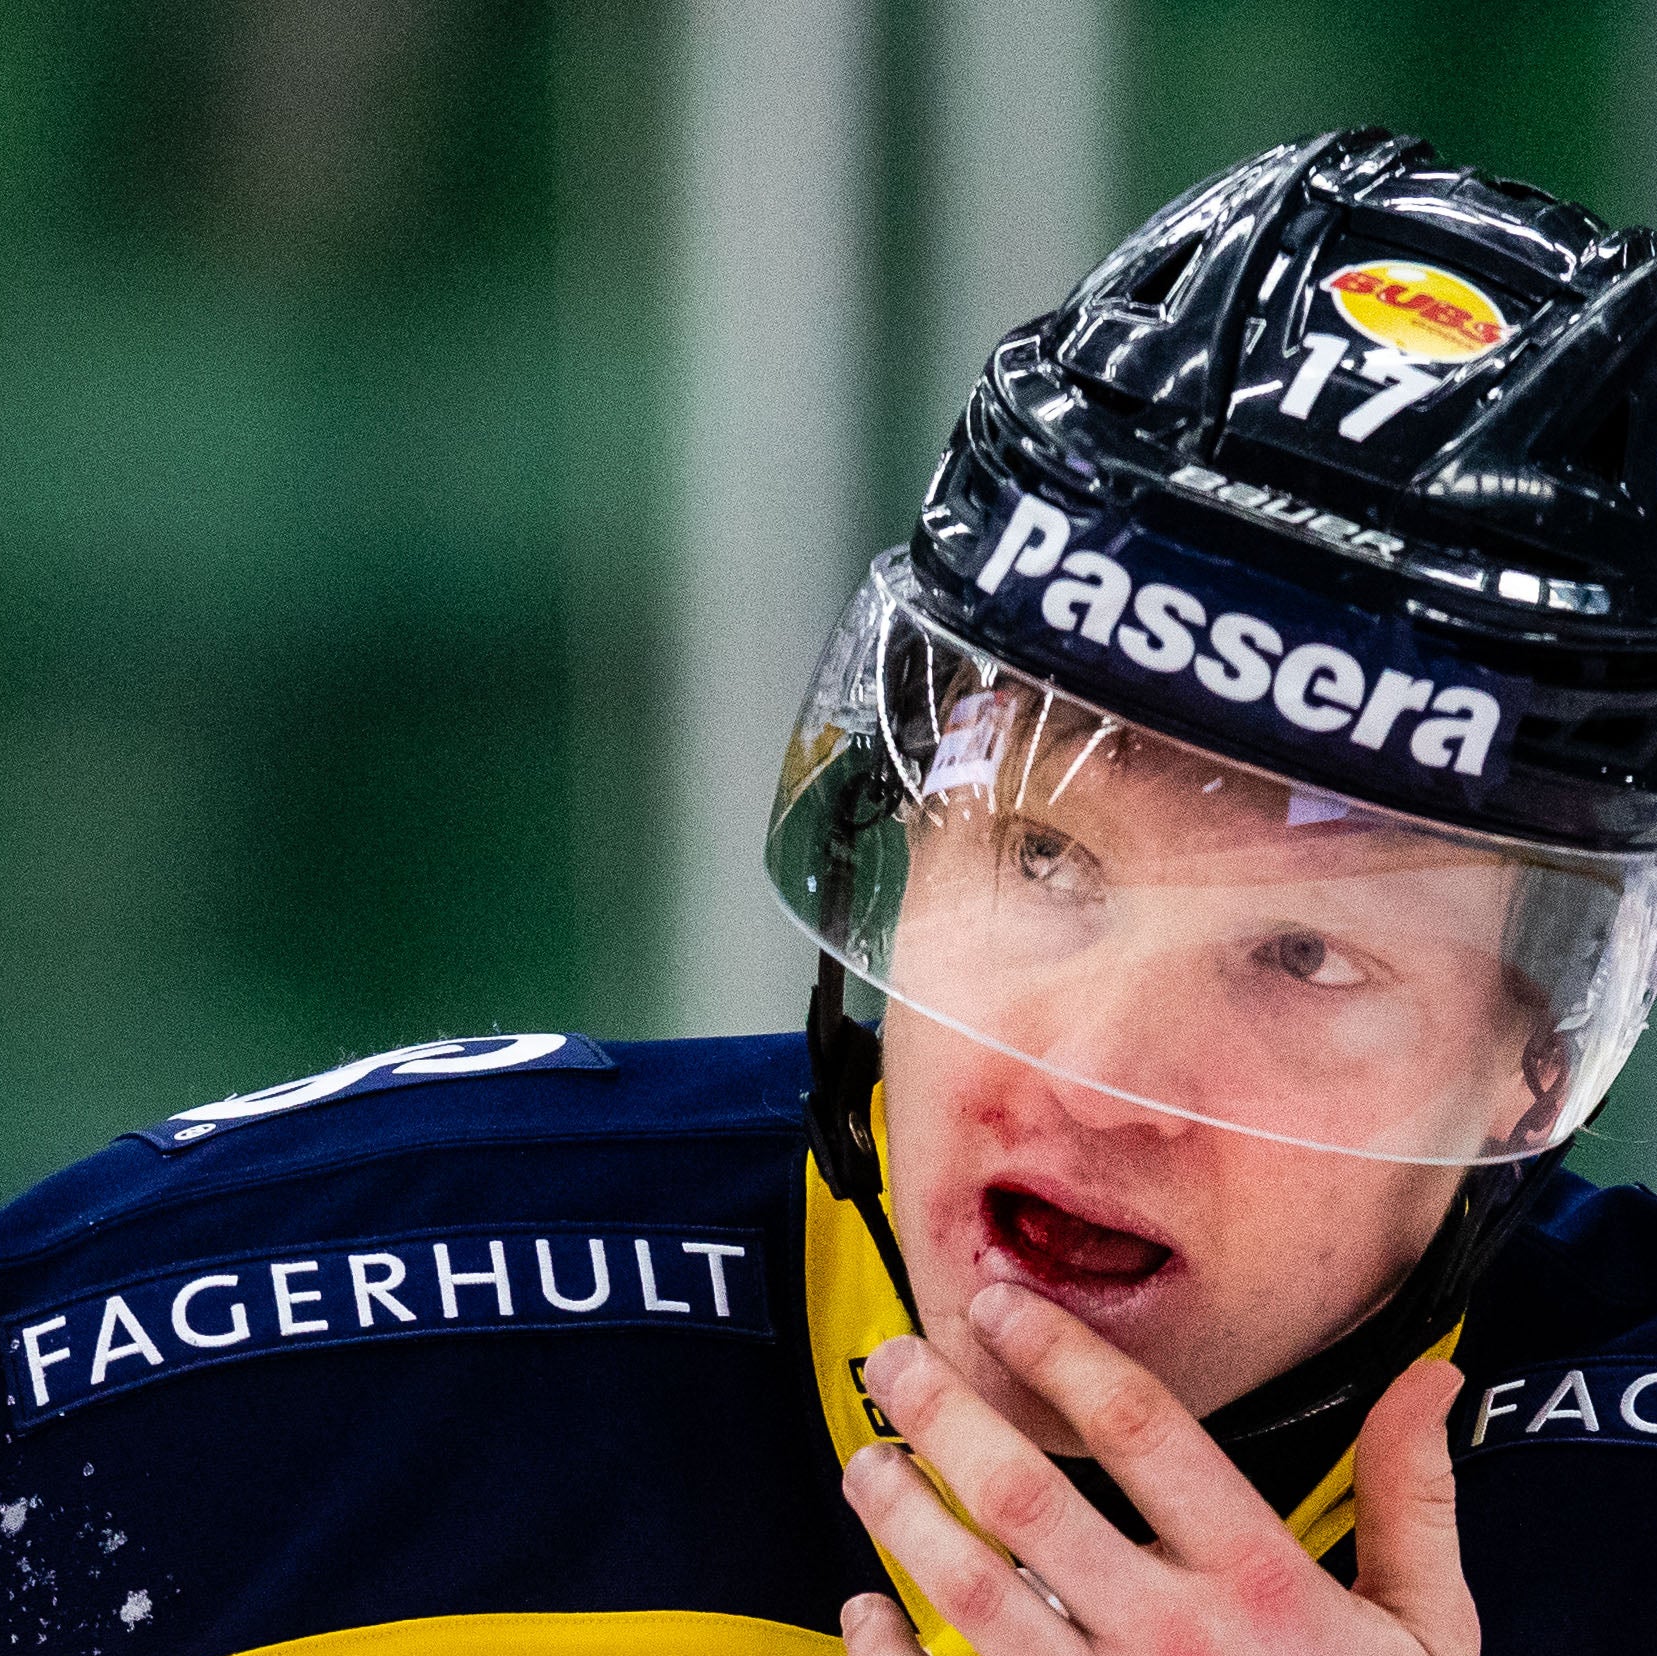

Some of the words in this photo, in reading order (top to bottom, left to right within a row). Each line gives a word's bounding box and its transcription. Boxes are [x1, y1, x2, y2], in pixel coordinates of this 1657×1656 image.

[1328, 270, 1504, 345] BUBS
[1277, 331, 1444, 443] 17
[977, 493, 1504, 776] Passera
[20, 1237, 746, 1407] FAGERHULT
